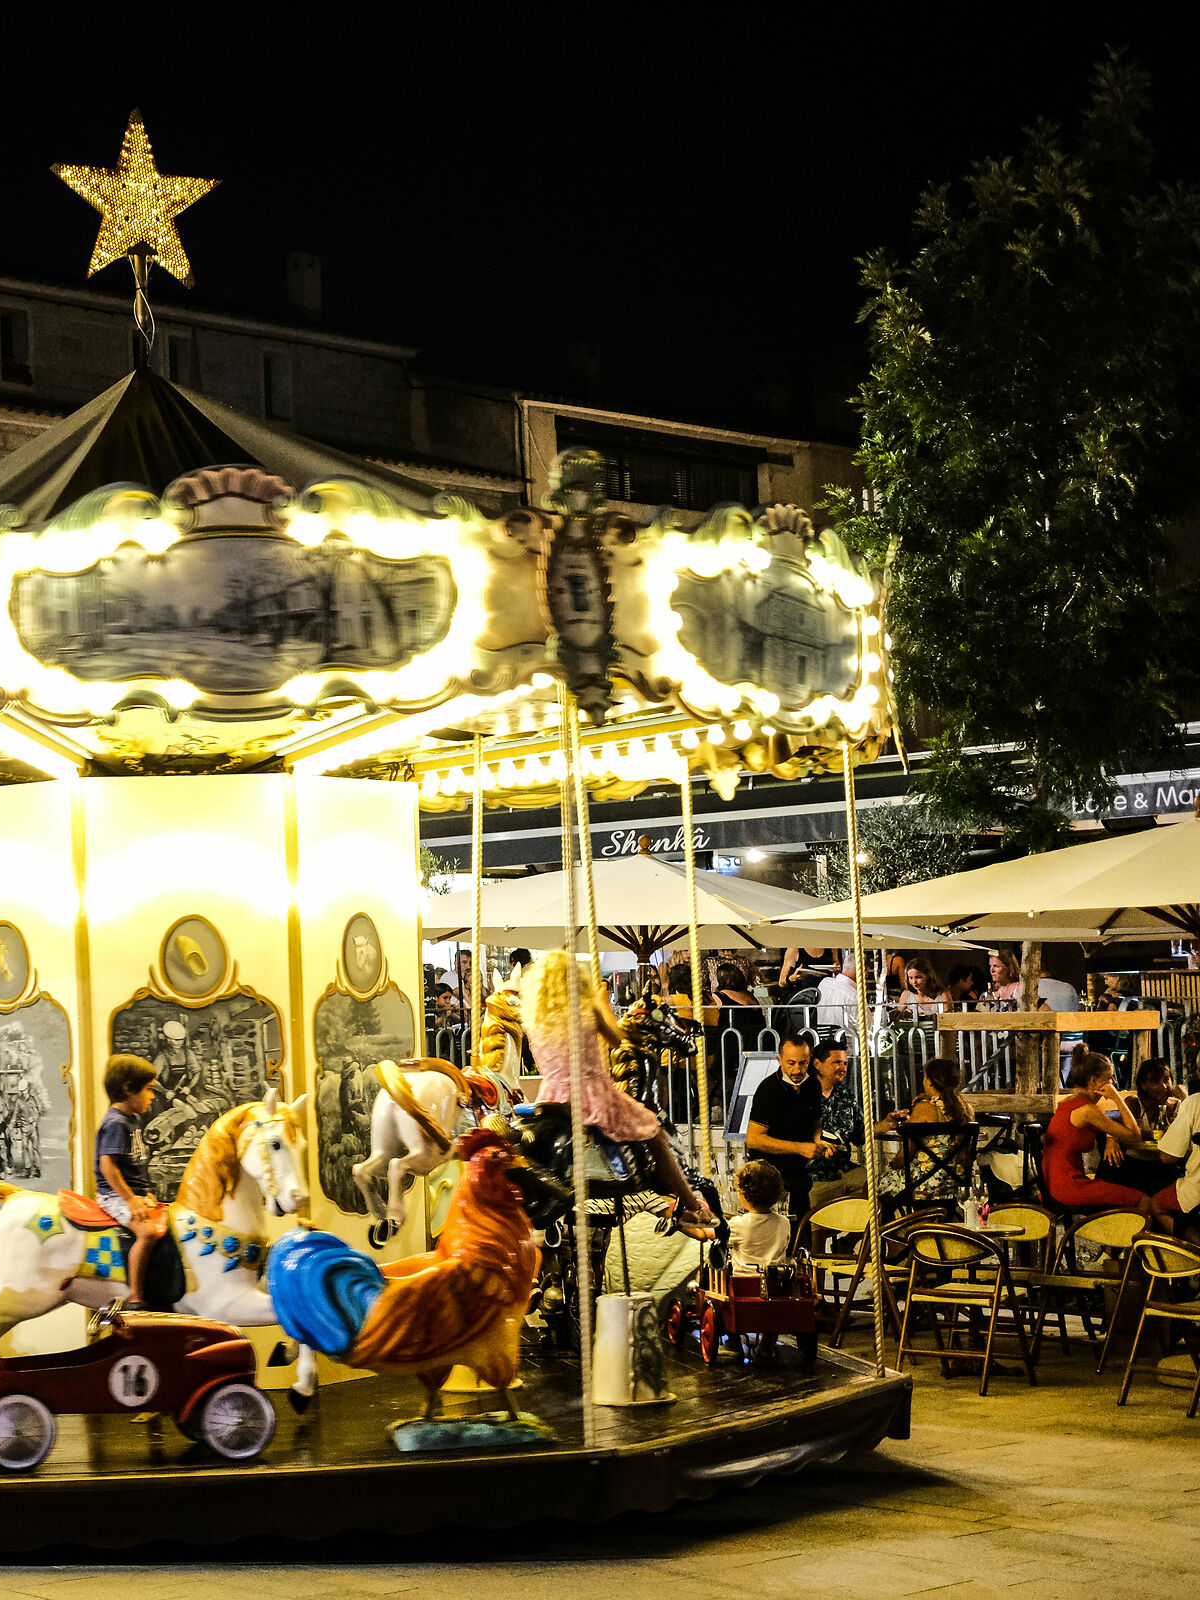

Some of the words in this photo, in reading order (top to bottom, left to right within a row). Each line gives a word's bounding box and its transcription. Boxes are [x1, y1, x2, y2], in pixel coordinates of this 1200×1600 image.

[1133, 792, 1148, 809] &
[601, 826, 710, 857] Shnkâ
[120, 1364, 148, 1397] 16
